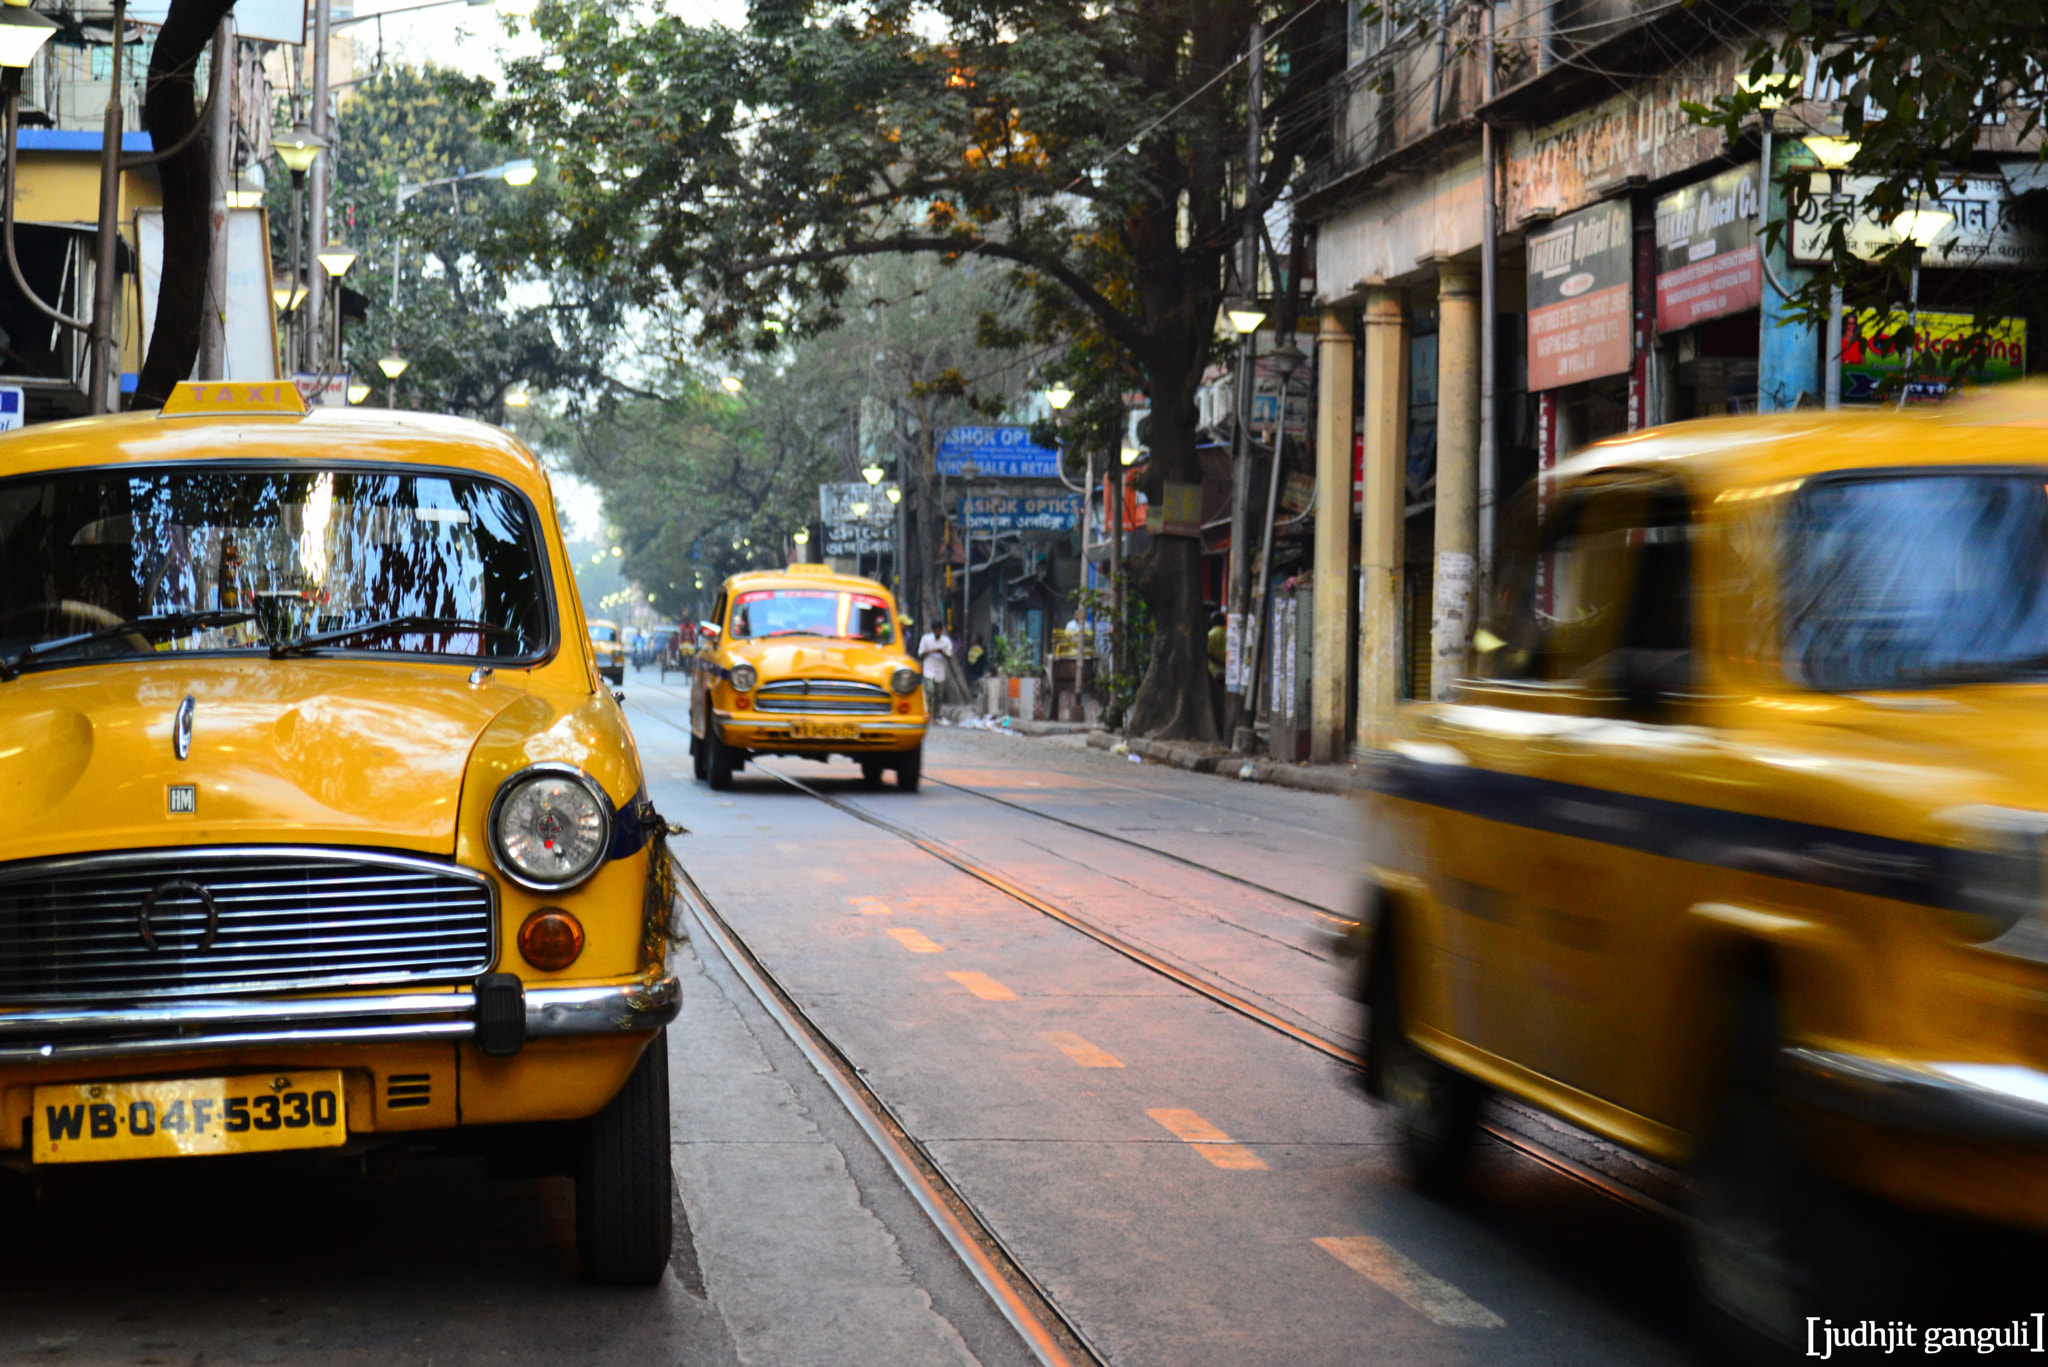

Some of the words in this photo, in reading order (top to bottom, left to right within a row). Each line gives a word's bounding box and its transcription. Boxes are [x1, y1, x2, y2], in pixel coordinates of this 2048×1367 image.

[1699, 179, 1738, 239] Optical
[1739, 174, 1760, 219] Co.
[1529, 226, 1575, 280] THAKKER
[1574, 210, 1611, 266] Optical
[1611, 208, 1628, 249] Co.
[190, 386, 281, 402] TAXI
[963, 499, 1017, 514] ASHOK
[1025, 499, 1079, 514] OPTICS
[171, 789, 192, 811] HM
